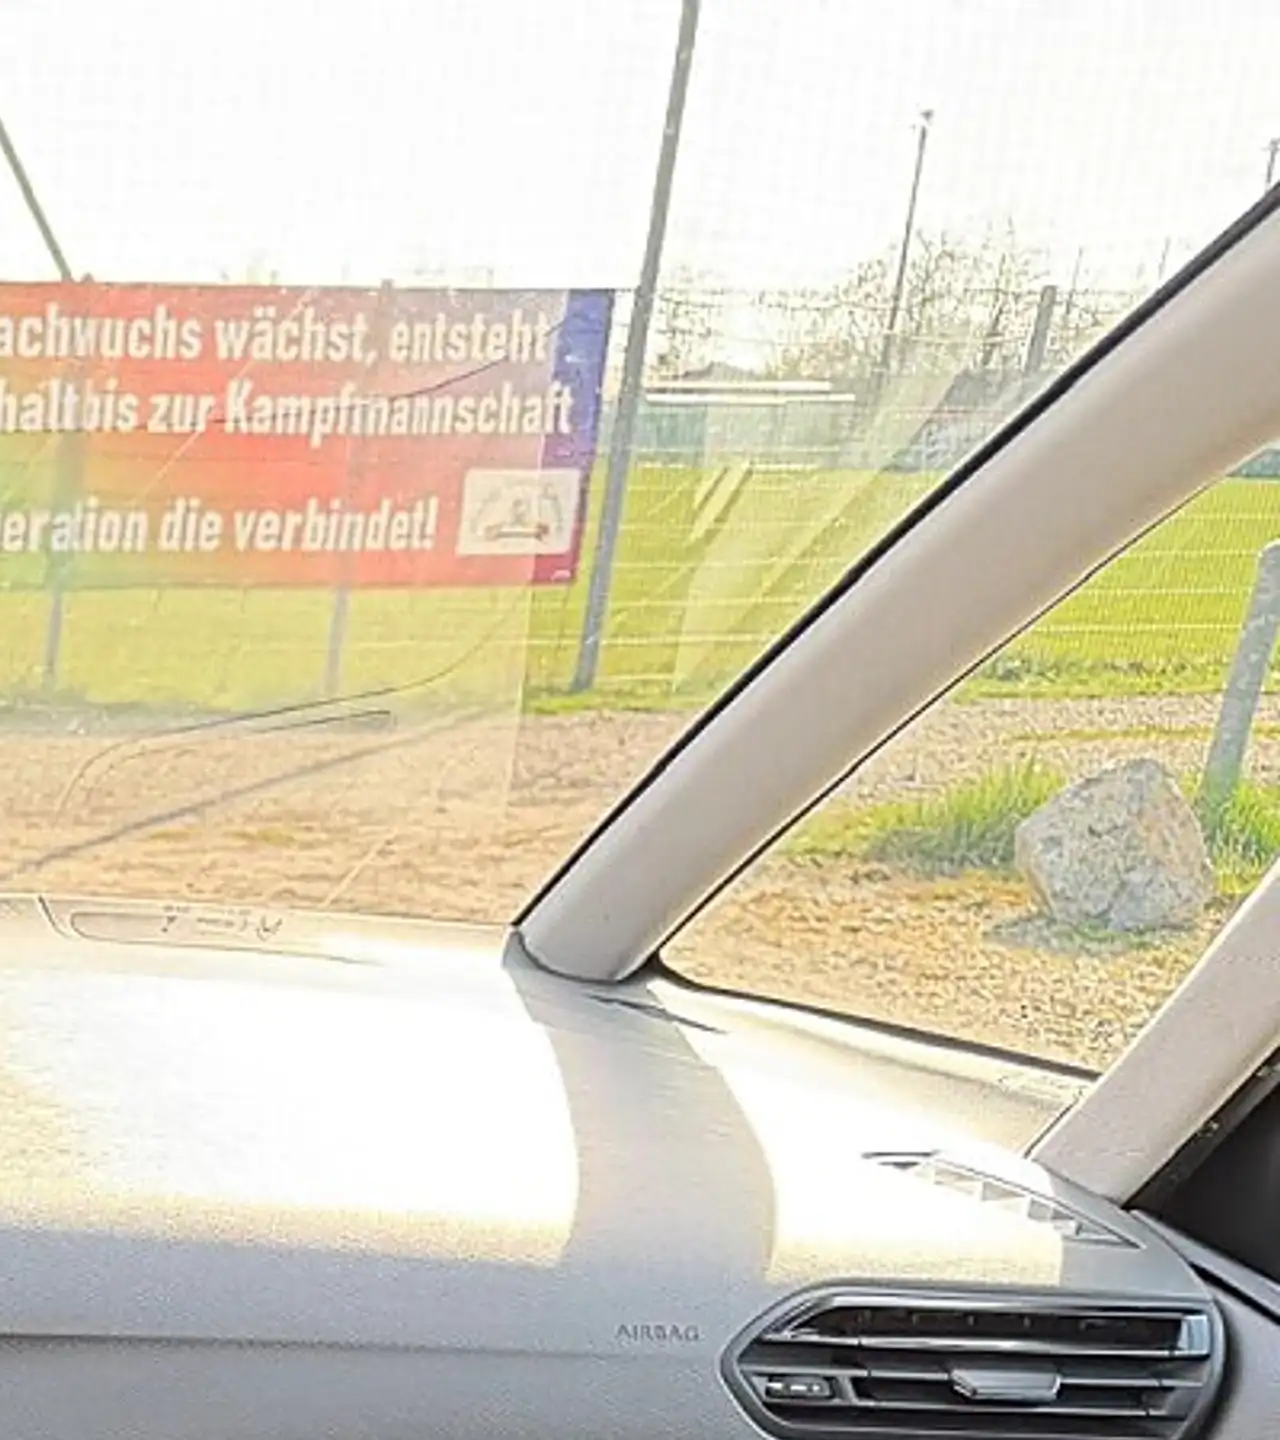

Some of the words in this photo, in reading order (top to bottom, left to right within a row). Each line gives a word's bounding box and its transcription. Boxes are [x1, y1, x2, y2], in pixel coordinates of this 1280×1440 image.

[215, 306, 378, 366] wächst,
[389, 308, 552, 362] entsteht
[83, 378, 139, 433] bis
[147, 393, 214, 434] zur
[224, 378, 574, 450] Kampfmannschaft
[158, 498, 223, 552] die
[233, 497, 440, 554] verbindet!
[615, 1323, 699, 1341] AIRBAG
